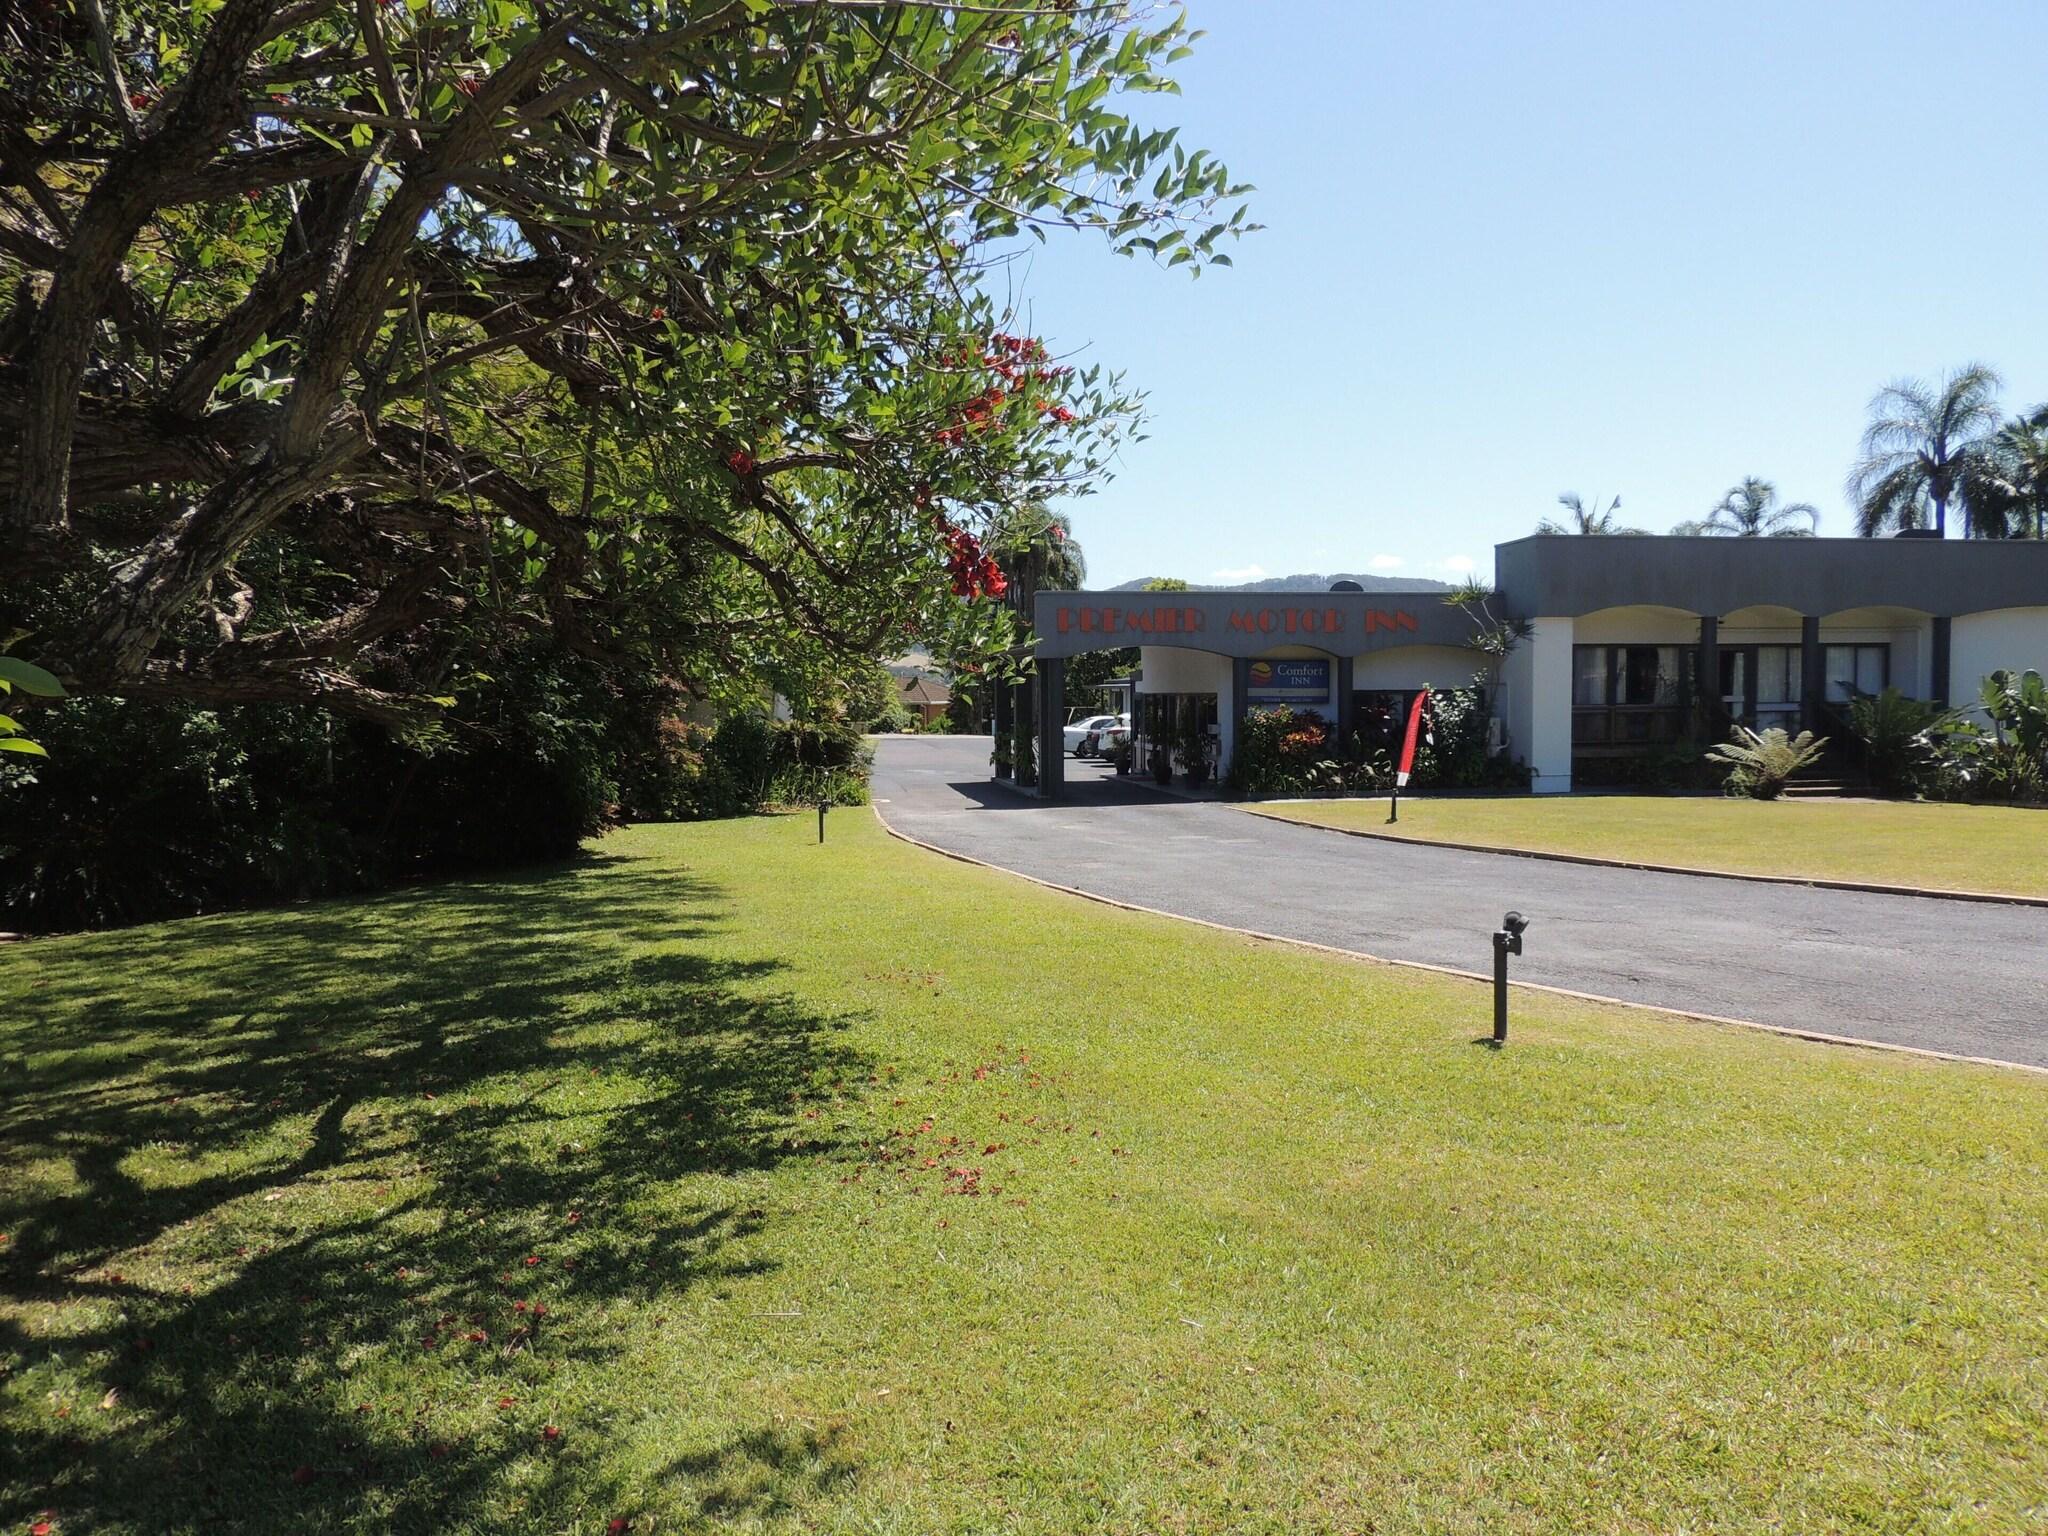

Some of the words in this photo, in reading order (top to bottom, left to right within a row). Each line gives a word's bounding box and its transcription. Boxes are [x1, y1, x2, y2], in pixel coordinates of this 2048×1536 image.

[1057, 608, 1206, 633] PREMIER
[1227, 608, 1343, 633] MOTOR
[1364, 609, 1418, 633] INN
[1277, 664, 1324, 676] Comfort
[1291, 676, 1311, 685] INN
